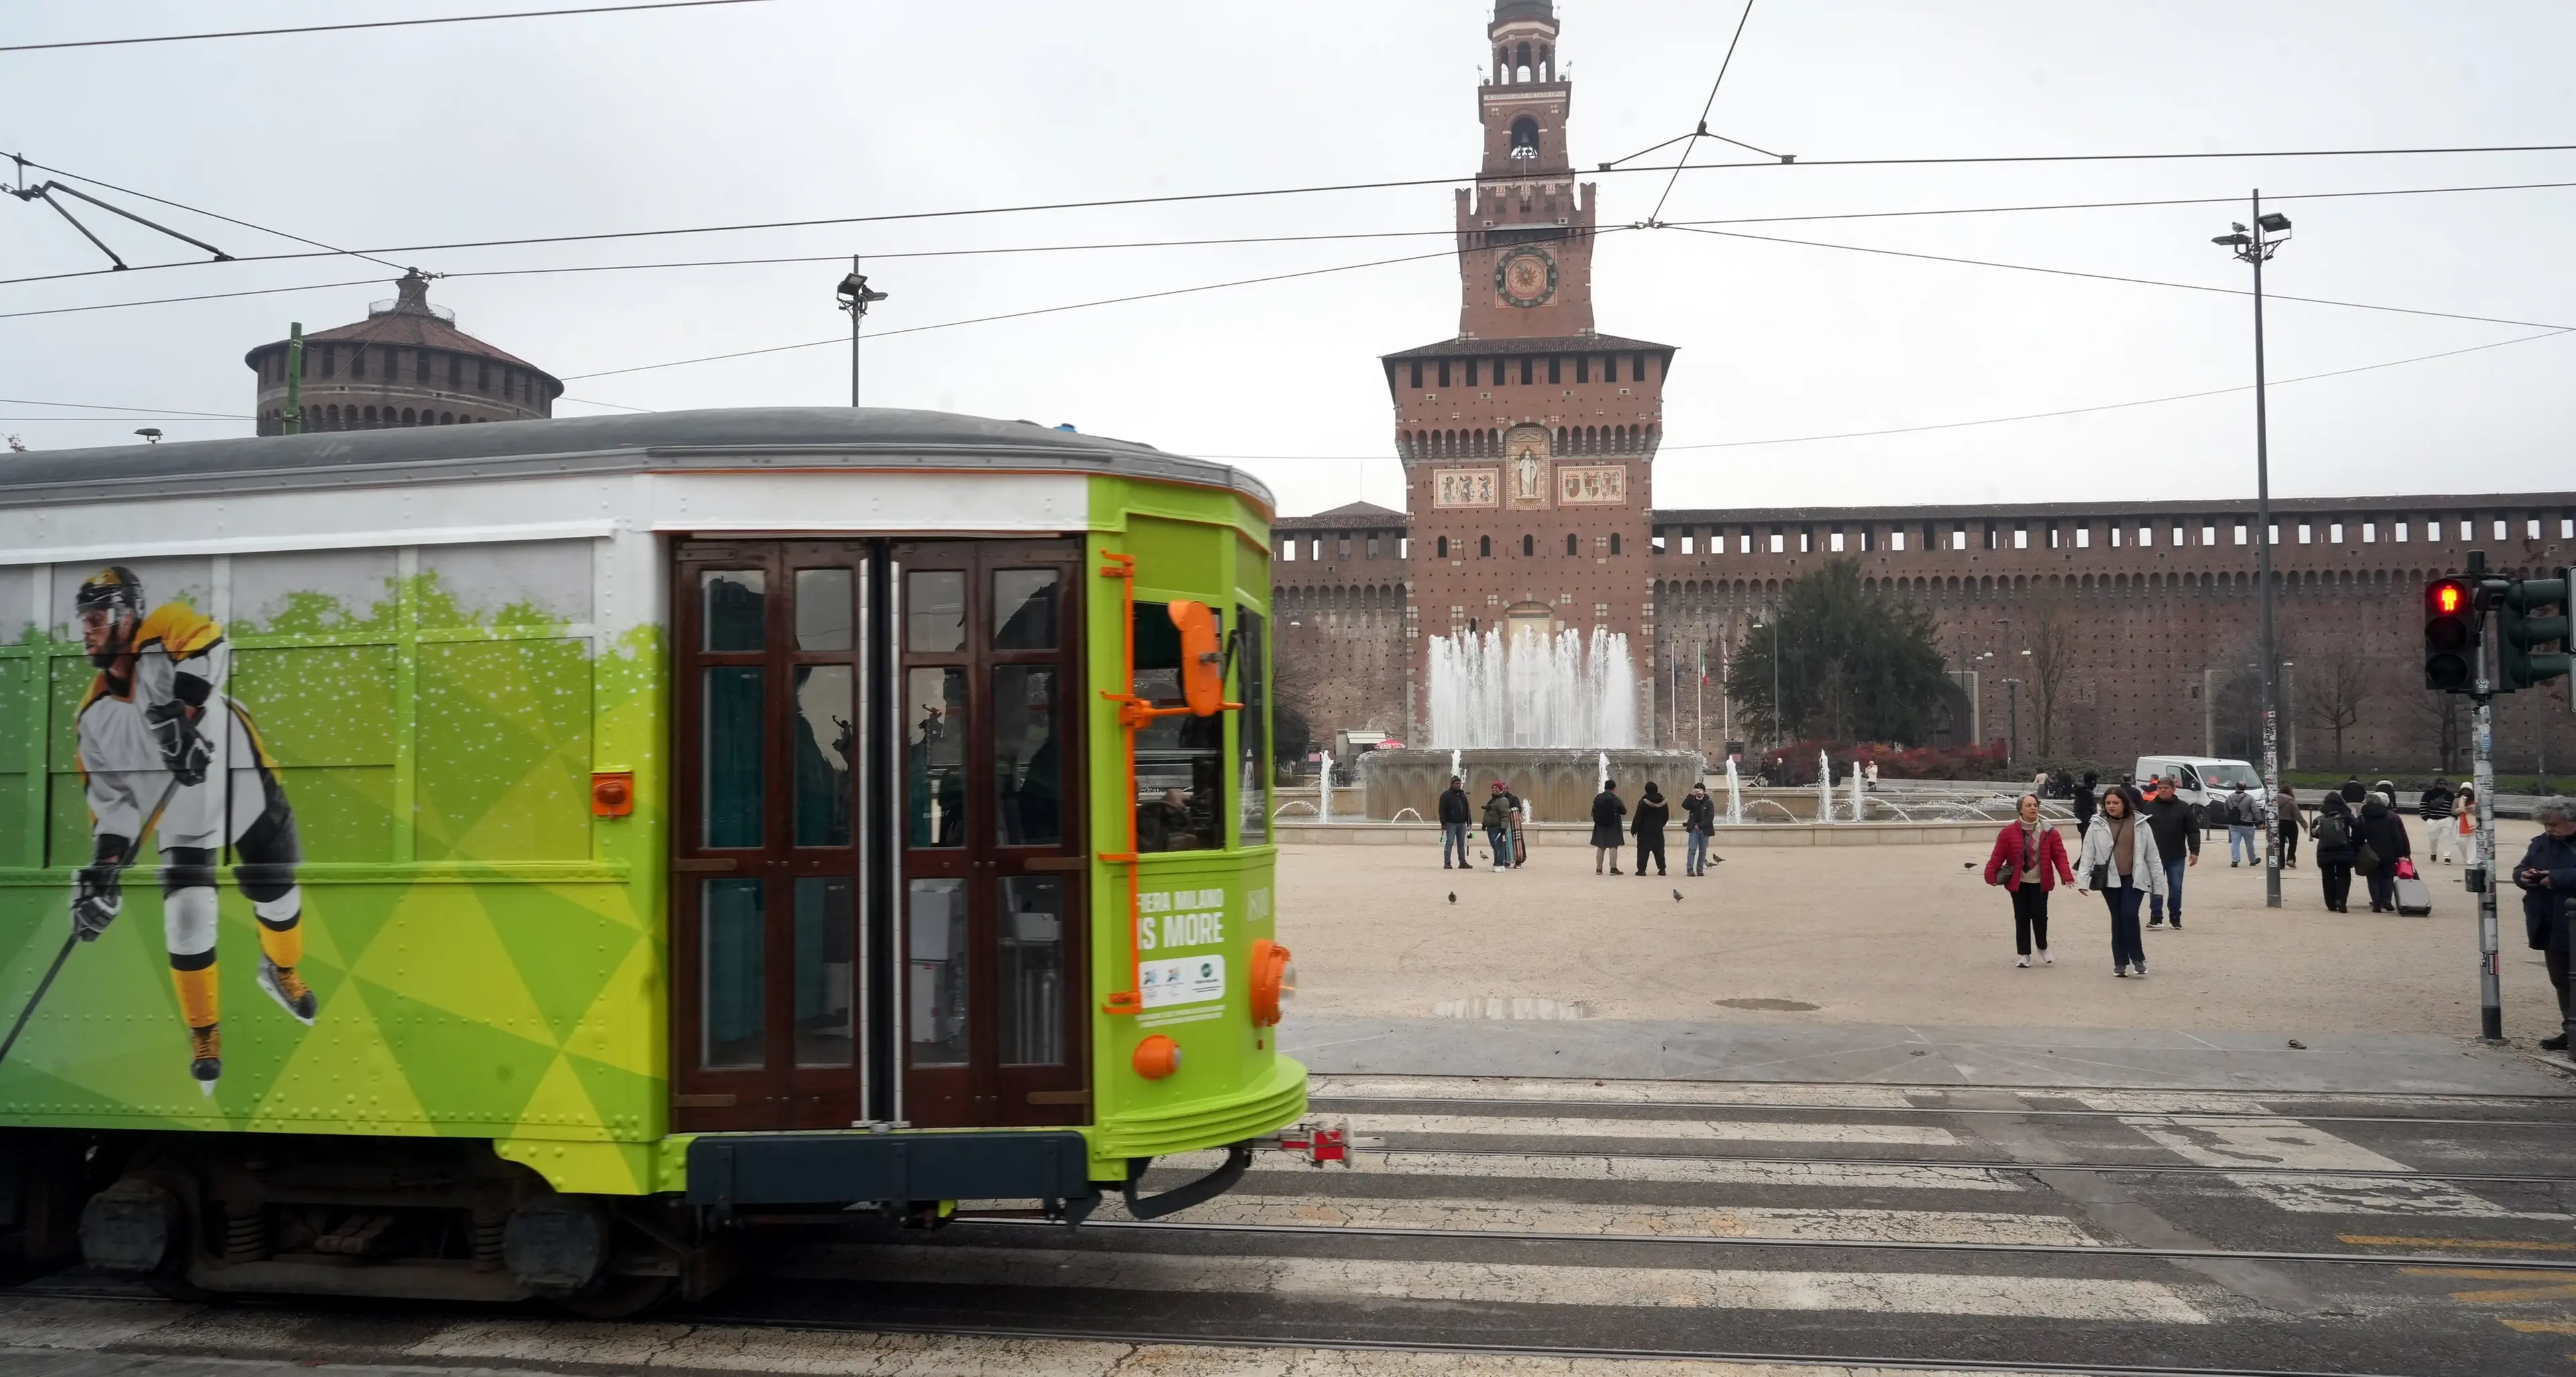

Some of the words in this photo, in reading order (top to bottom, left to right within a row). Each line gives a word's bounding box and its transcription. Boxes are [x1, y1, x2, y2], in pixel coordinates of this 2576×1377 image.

[1174, 888, 1224, 911] MILANO
[1137, 917, 1157, 950] IS
[1163, 911, 1224, 948] MORE
